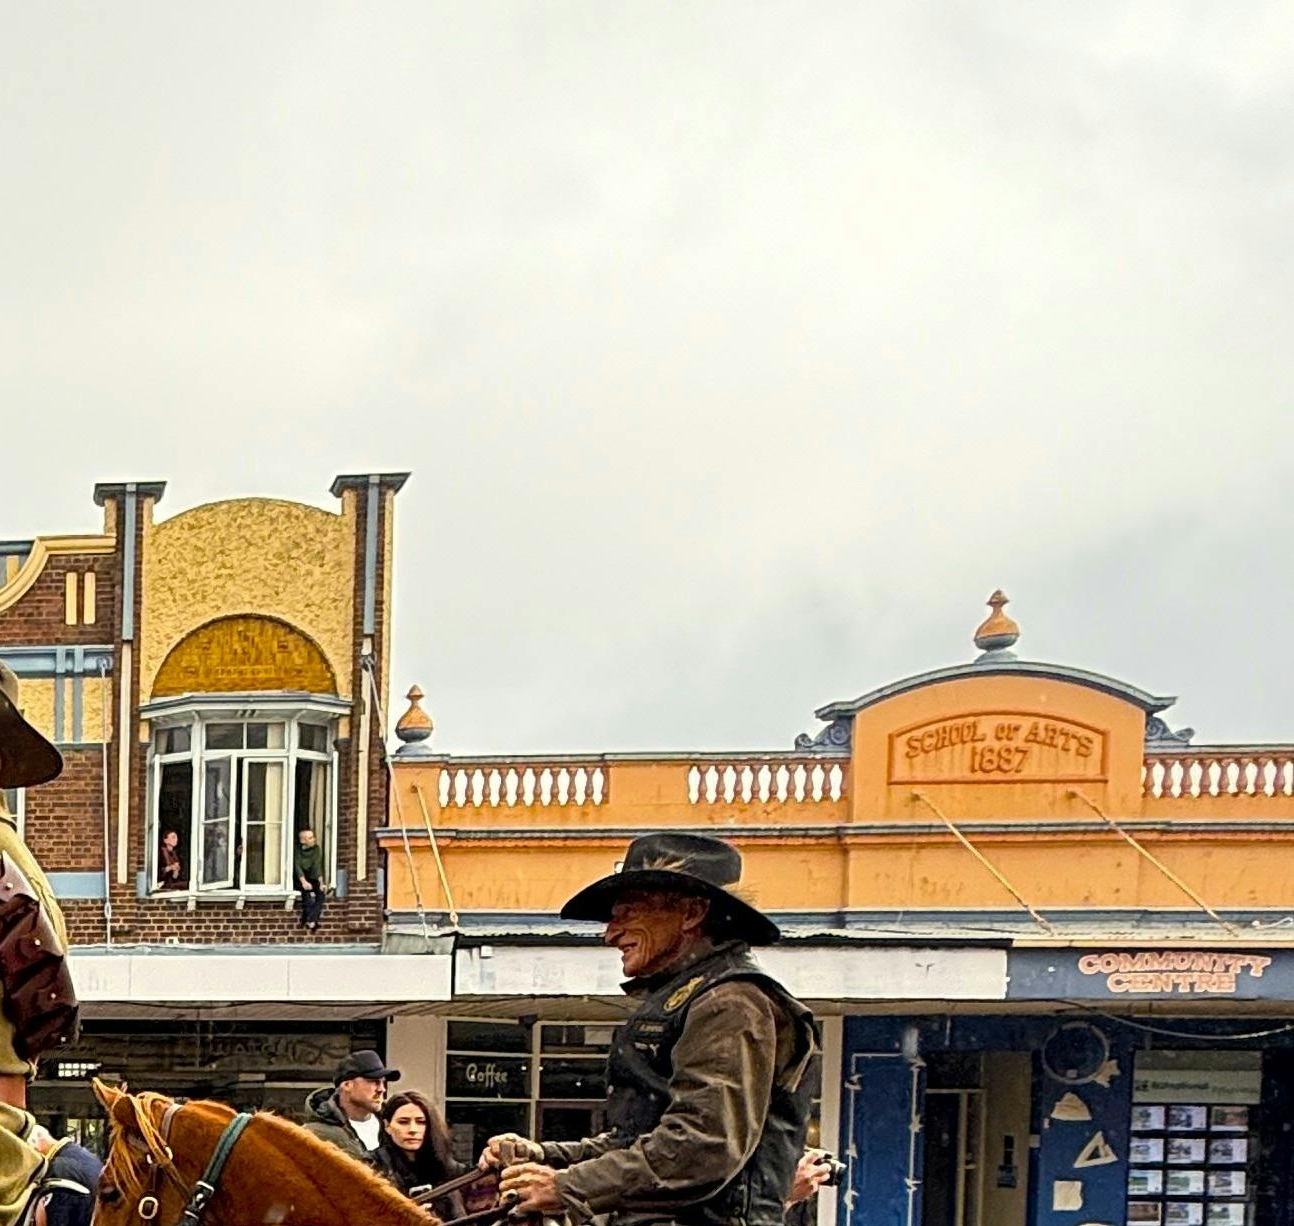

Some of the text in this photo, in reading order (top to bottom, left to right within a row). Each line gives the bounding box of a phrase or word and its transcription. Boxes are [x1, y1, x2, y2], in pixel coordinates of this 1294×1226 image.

[905, 720, 987, 759] SCHOOL
[1024, 721, 1094, 758] ARTS
[970, 745, 1030, 773] 1887
[1078, 951, 1272, 977] COMMUNITY
[1106, 972, 1237, 993] CENTRE
[466, 1063, 508, 1087] Coffee
